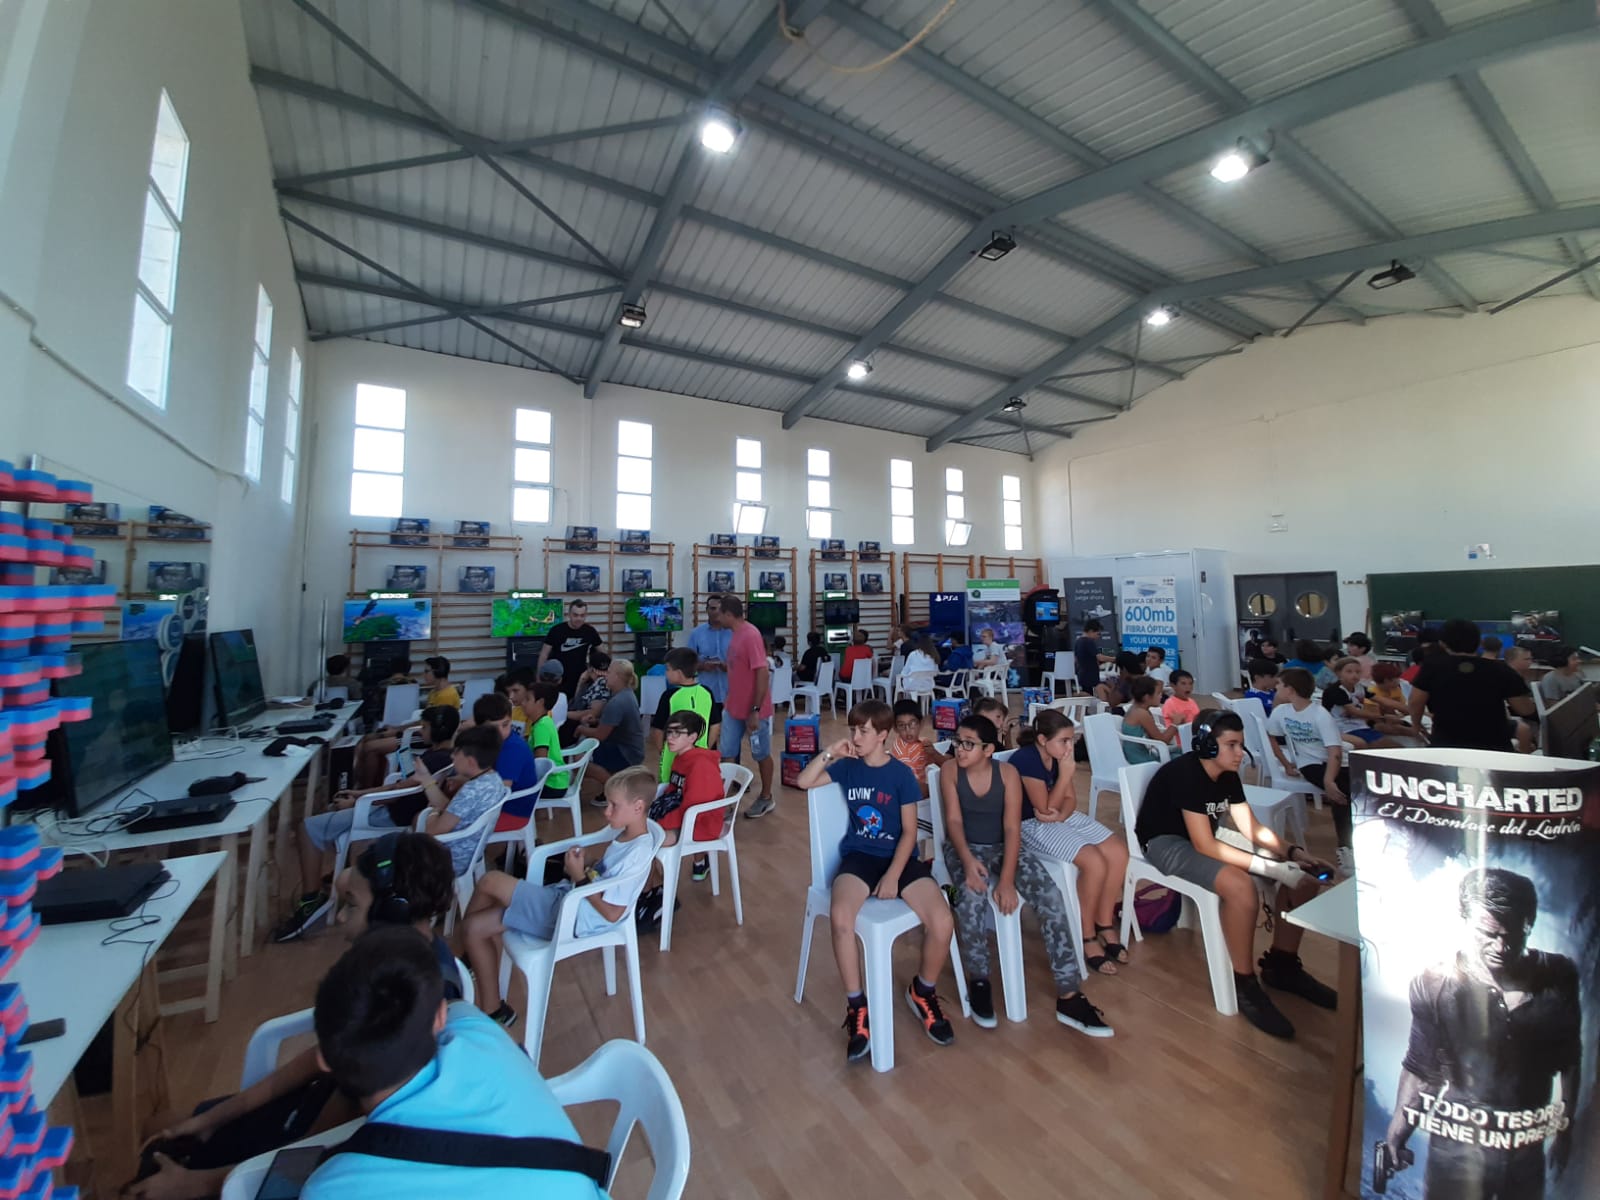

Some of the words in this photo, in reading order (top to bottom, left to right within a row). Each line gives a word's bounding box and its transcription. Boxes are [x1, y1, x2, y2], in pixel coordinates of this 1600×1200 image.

[1125, 605, 1175, 622] 600mb
[1125, 625, 1146, 634] FIBRA
[1147, 623, 1175, 634] ÓPTICA
[1129, 636, 1147, 644] YOUR
[1148, 636, 1169, 645] LOCAL
[848, 787, 875, 801] LIVIN'
[876, 791, 893, 805] BY
[1365, 769, 1583, 813] UNCHARTED
[1378, 802, 1403, 818] El
[1404, 807, 1496, 834] Desenlace
[1499, 818, 1524, 835] del
[1527, 816, 1582, 840] Ladrón
[1419, 1091, 1488, 1126] TODO
[1493, 1101, 1566, 1130] TESORO
[1403, 1106, 1475, 1144] TIENE
[1479, 1131, 1512, 1149] UN
